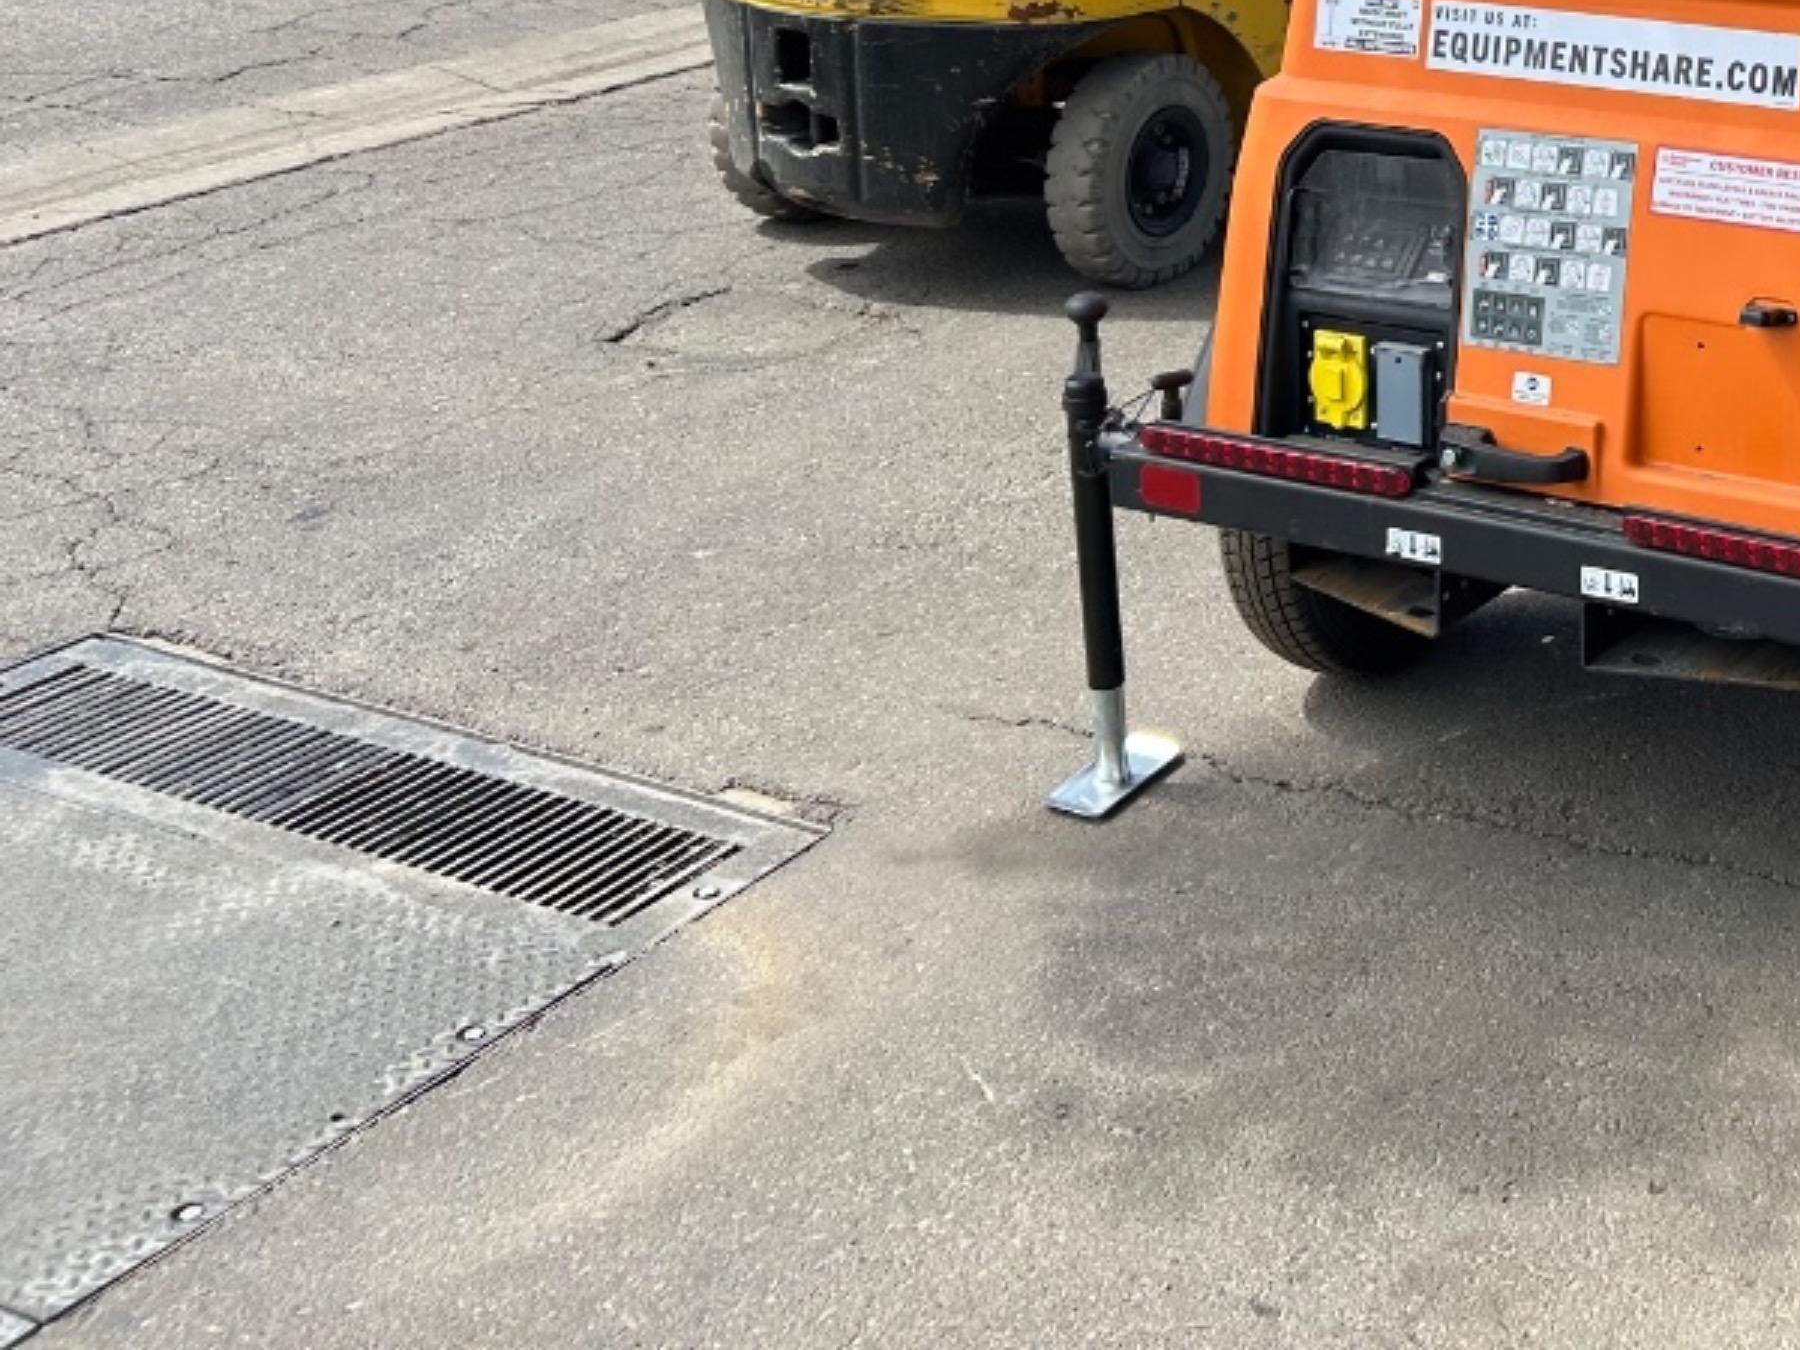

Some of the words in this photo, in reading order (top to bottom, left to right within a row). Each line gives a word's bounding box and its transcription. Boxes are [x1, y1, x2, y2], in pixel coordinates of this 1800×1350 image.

[1435, 6, 1478, 24] VISIT
[1484, 10, 1505, 27] US
[1511, 14, 1537, 29] AT:
[1432, 29, 1798, 97] EQUIPMENTSHARE.COM
